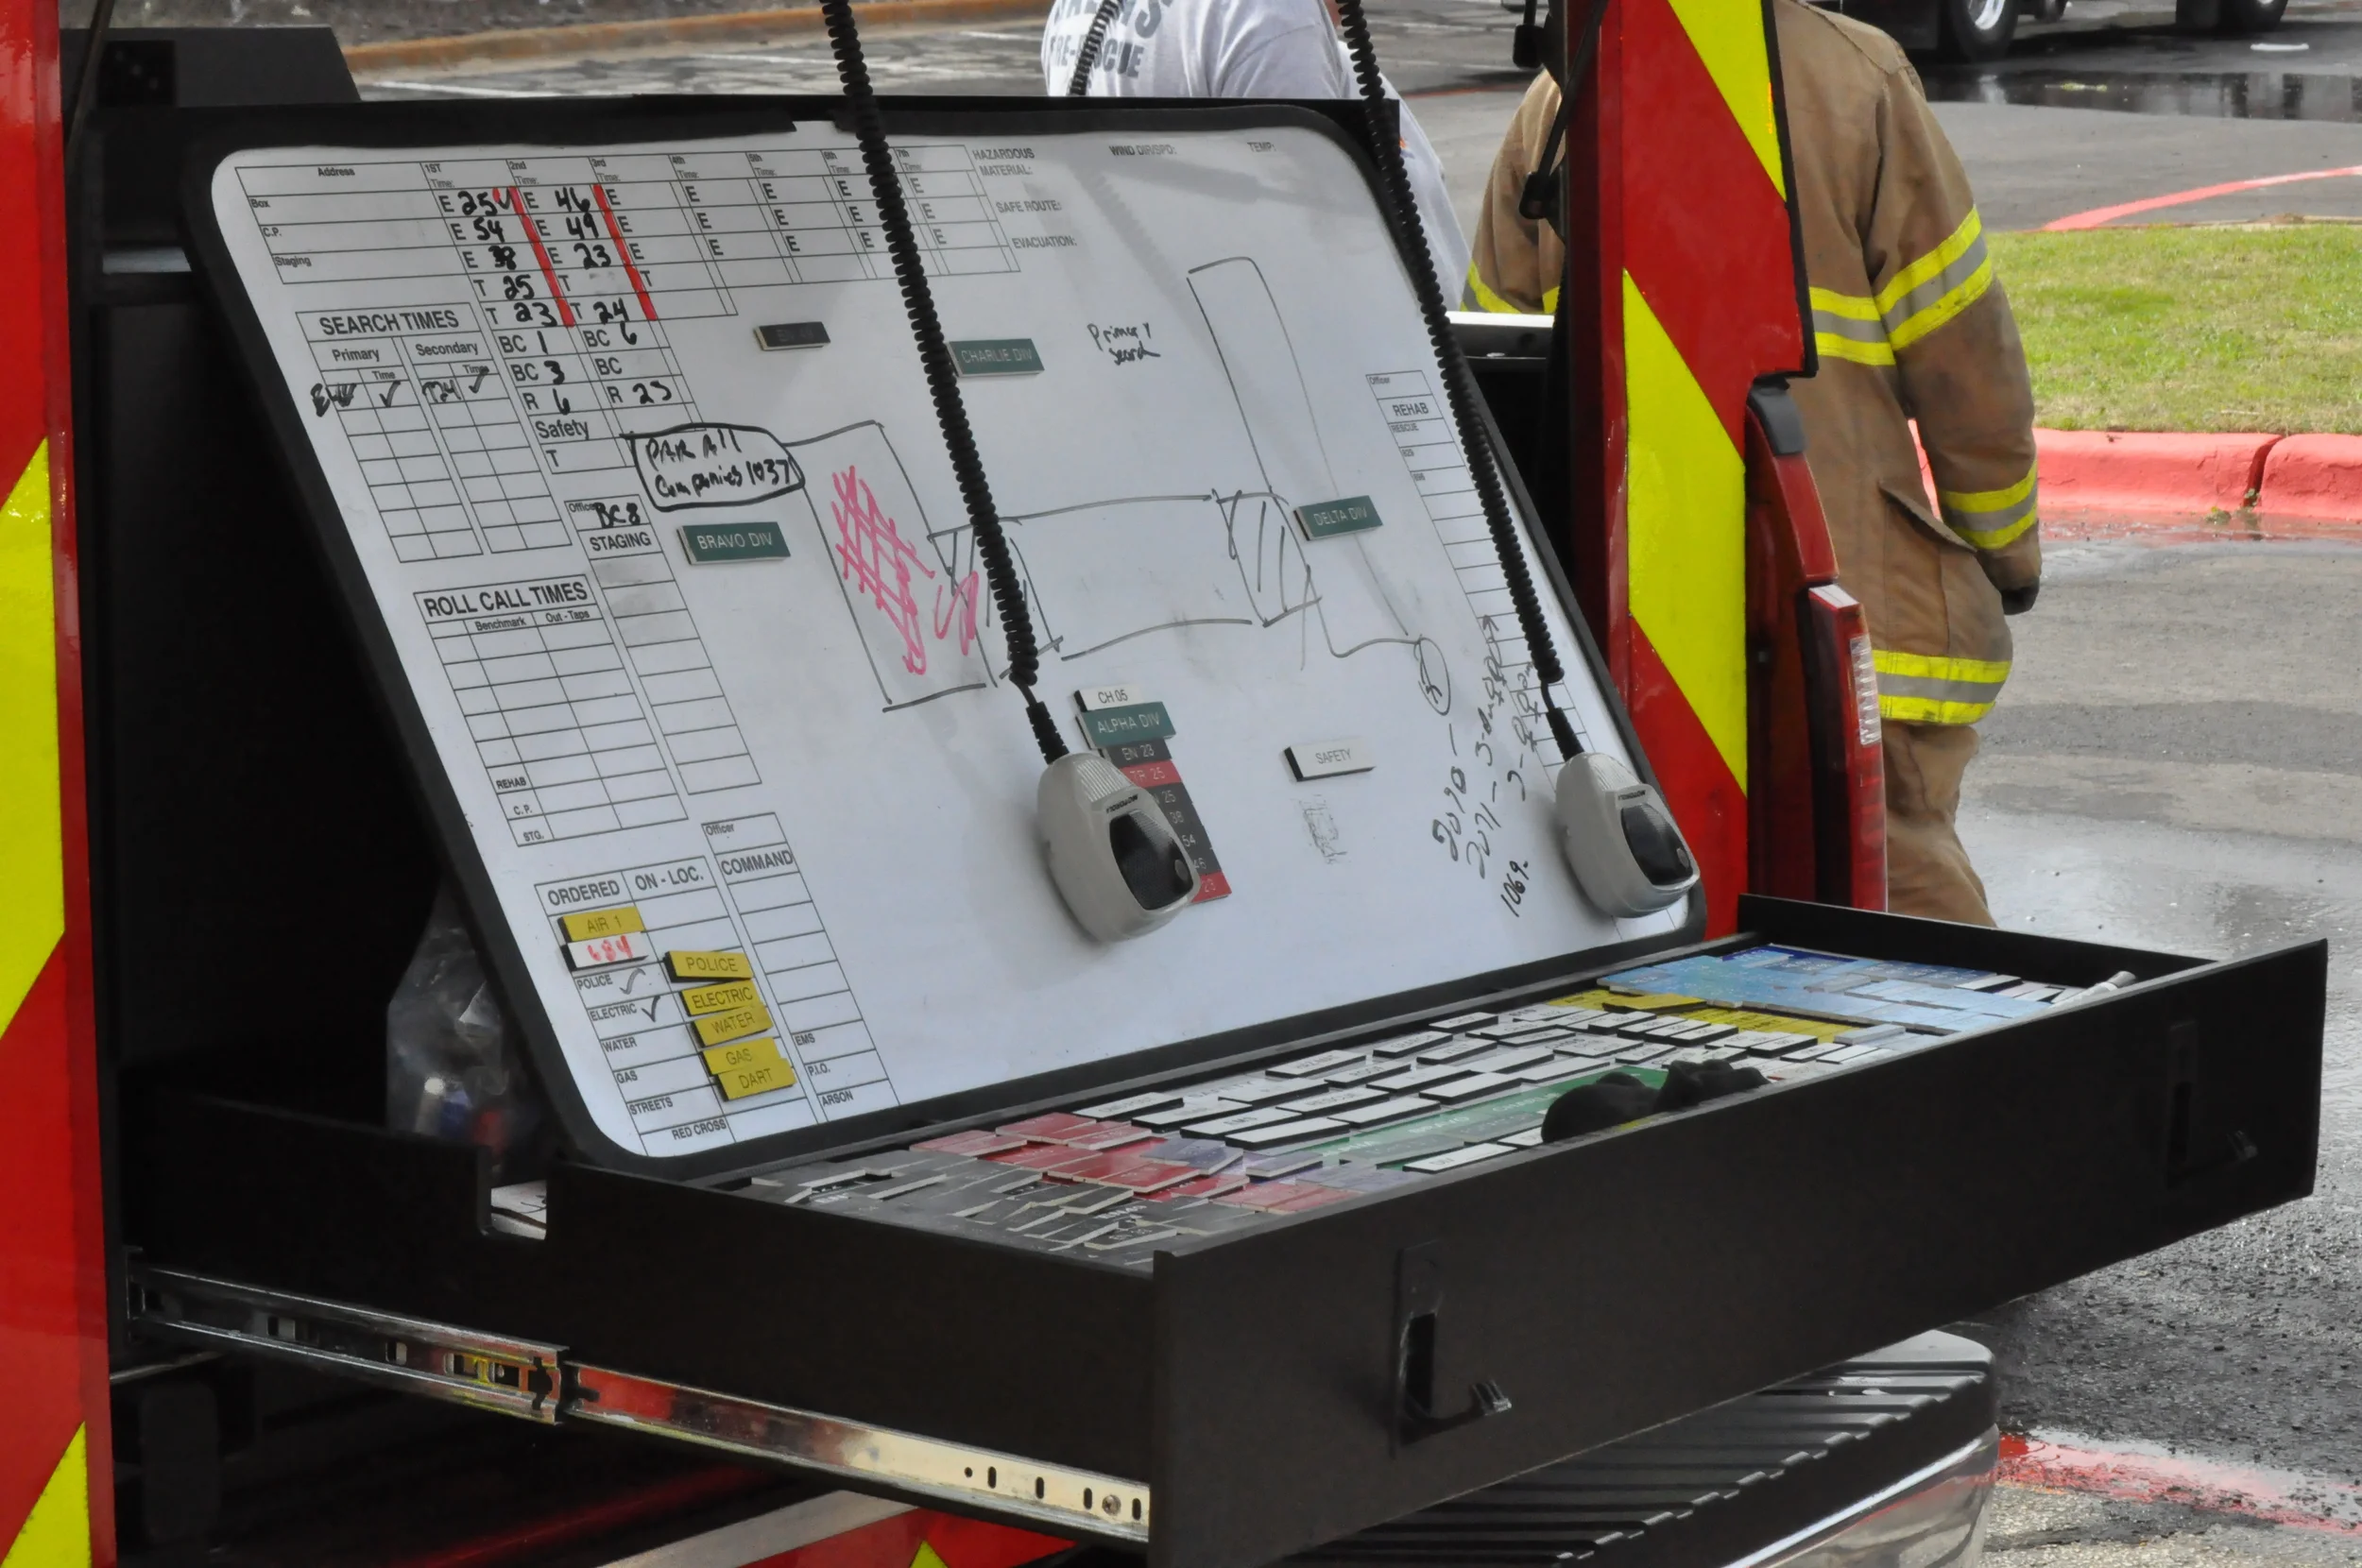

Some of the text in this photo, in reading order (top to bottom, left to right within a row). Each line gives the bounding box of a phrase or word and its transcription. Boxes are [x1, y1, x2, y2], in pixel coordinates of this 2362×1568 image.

[972, 148, 1035, 161] HAZARDOUS
[1109, 145, 1135, 156] WIND
[425, 163, 441, 174] 1ST
[509, 161, 526, 170] 2nd
[591, 158, 607, 168] 3rd
[979, 164, 1033, 177] MATERIAL:
[317, 166, 355, 178] Address
[685, 186, 700, 202] E
[762, 183, 777, 199] E
[837, 180, 852, 196] E
[910, 178, 924, 194] E
[251, 198, 270, 209] Box
[438, 196, 454, 213] E
[457, 191, 498, 216] 25
[523, 192, 539, 209] E
[555, 186, 590, 213] 46
[607, 190, 621, 205] E
[921, 203, 935, 219] E
[996, 199, 1062, 213] SAFE ROUTE:
[696, 213, 712, 229] E
[774, 210, 789, 226] E
[849, 207, 864, 222] E
[450, 223, 467, 240] E
[472, 216, 505, 243] 54
[535, 219, 551, 236] E
[566, 213, 599, 240] 49
[617, 216, 633, 232] E
[786, 235, 800, 251] E
[861, 232, 875, 247] E
[933, 229, 947, 245] E
[1012, 236, 1077, 249] EVACUATION:
[629, 243, 644, 260] E
[709, 239, 724, 255] E
[275, 255, 312, 267] Staging
[462, 251, 478, 268] E
[547, 247, 562, 264] E
[573, 243, 611, 269] 23
[558, 275, 571, 291] T
[641, 271, 652, 286] T
[473, 280, 487, 297] T
[504, 275, 535, 300] 25
[486, 307, 500, 324] T
[571, 303, 583, 319] T
[593, 297, 629, 325] 24
[319, 310, 459, 335] SEARCH TIMES
[583, 330, 610, 348] BC
[620, 321, 638, 345] 6
[416, 342, 478, 356] Secondary
[499, 335, 527, 353] BC
[332, 349, 380, 362] Primary
[961, 349, 1033, 364] CHARLIE DIV
[371, 370, 395, 380] Time
[510, 364, 539, 383] BC
[543, 360, 565, 384] 3
[594, 358, 623, 376] BC
[523, 393, 539, 411] R
[607, 386, 623, 403] R
[1393, 402, 1429, 417] REHAB
[535, 419, 590, 441] Safety
[546, 451, 559, 468] T
[1313, 506, 1367, 525] DELTA DIV
[590, 532, 652, 552] STAGING
[696, 533, 773, 551] BRAVO DIV
[424, 581, 588, 619] ROLL CALL TIMES
[545, 608, 590, 622] Out Taps
[475, 616, 527, 632] Benchmark
[1098, 689, 1128, 704] CH 05
[1097, 712, 1159, 734] ALPHA DIV
[1121, 747, 1138, 761] EN
[1315, 749, 1351, 764] SAFETY
[496, 777, 527, 791] REHAB
[523, 830, 544, 843] STG.
[706, 823, 734, 836] Officer
[721, 850, 794, 876] COMMAND
[635, 866, 704, 891] ON LOC.
[547, 880, 621, 907] ORDERED
[587, 916, 622, 932] AIR 1
[686, 957, 738, 972] POLICE
[576, 974, 613, 991] POLICE
[692, 987, 753, 1009] ELECTRIC
[590, 1003, 637, 1022] ELECTRIC
[711, 1012, 755, 1033] WATER
[603, 1037, 638, 1053] WATER
[795, 1032, 815, 1046] EMS
[726, 1050, 752, 1065] GAS
[616, 1070, 639, 1083] GAS
[738, 1068, 773, 1089] DART
[629, 1097, 674, 1116] STREETS
[821, 1091, 854, 1107] ARSON
[672, 1118, 727, 1140] RED CROSS
